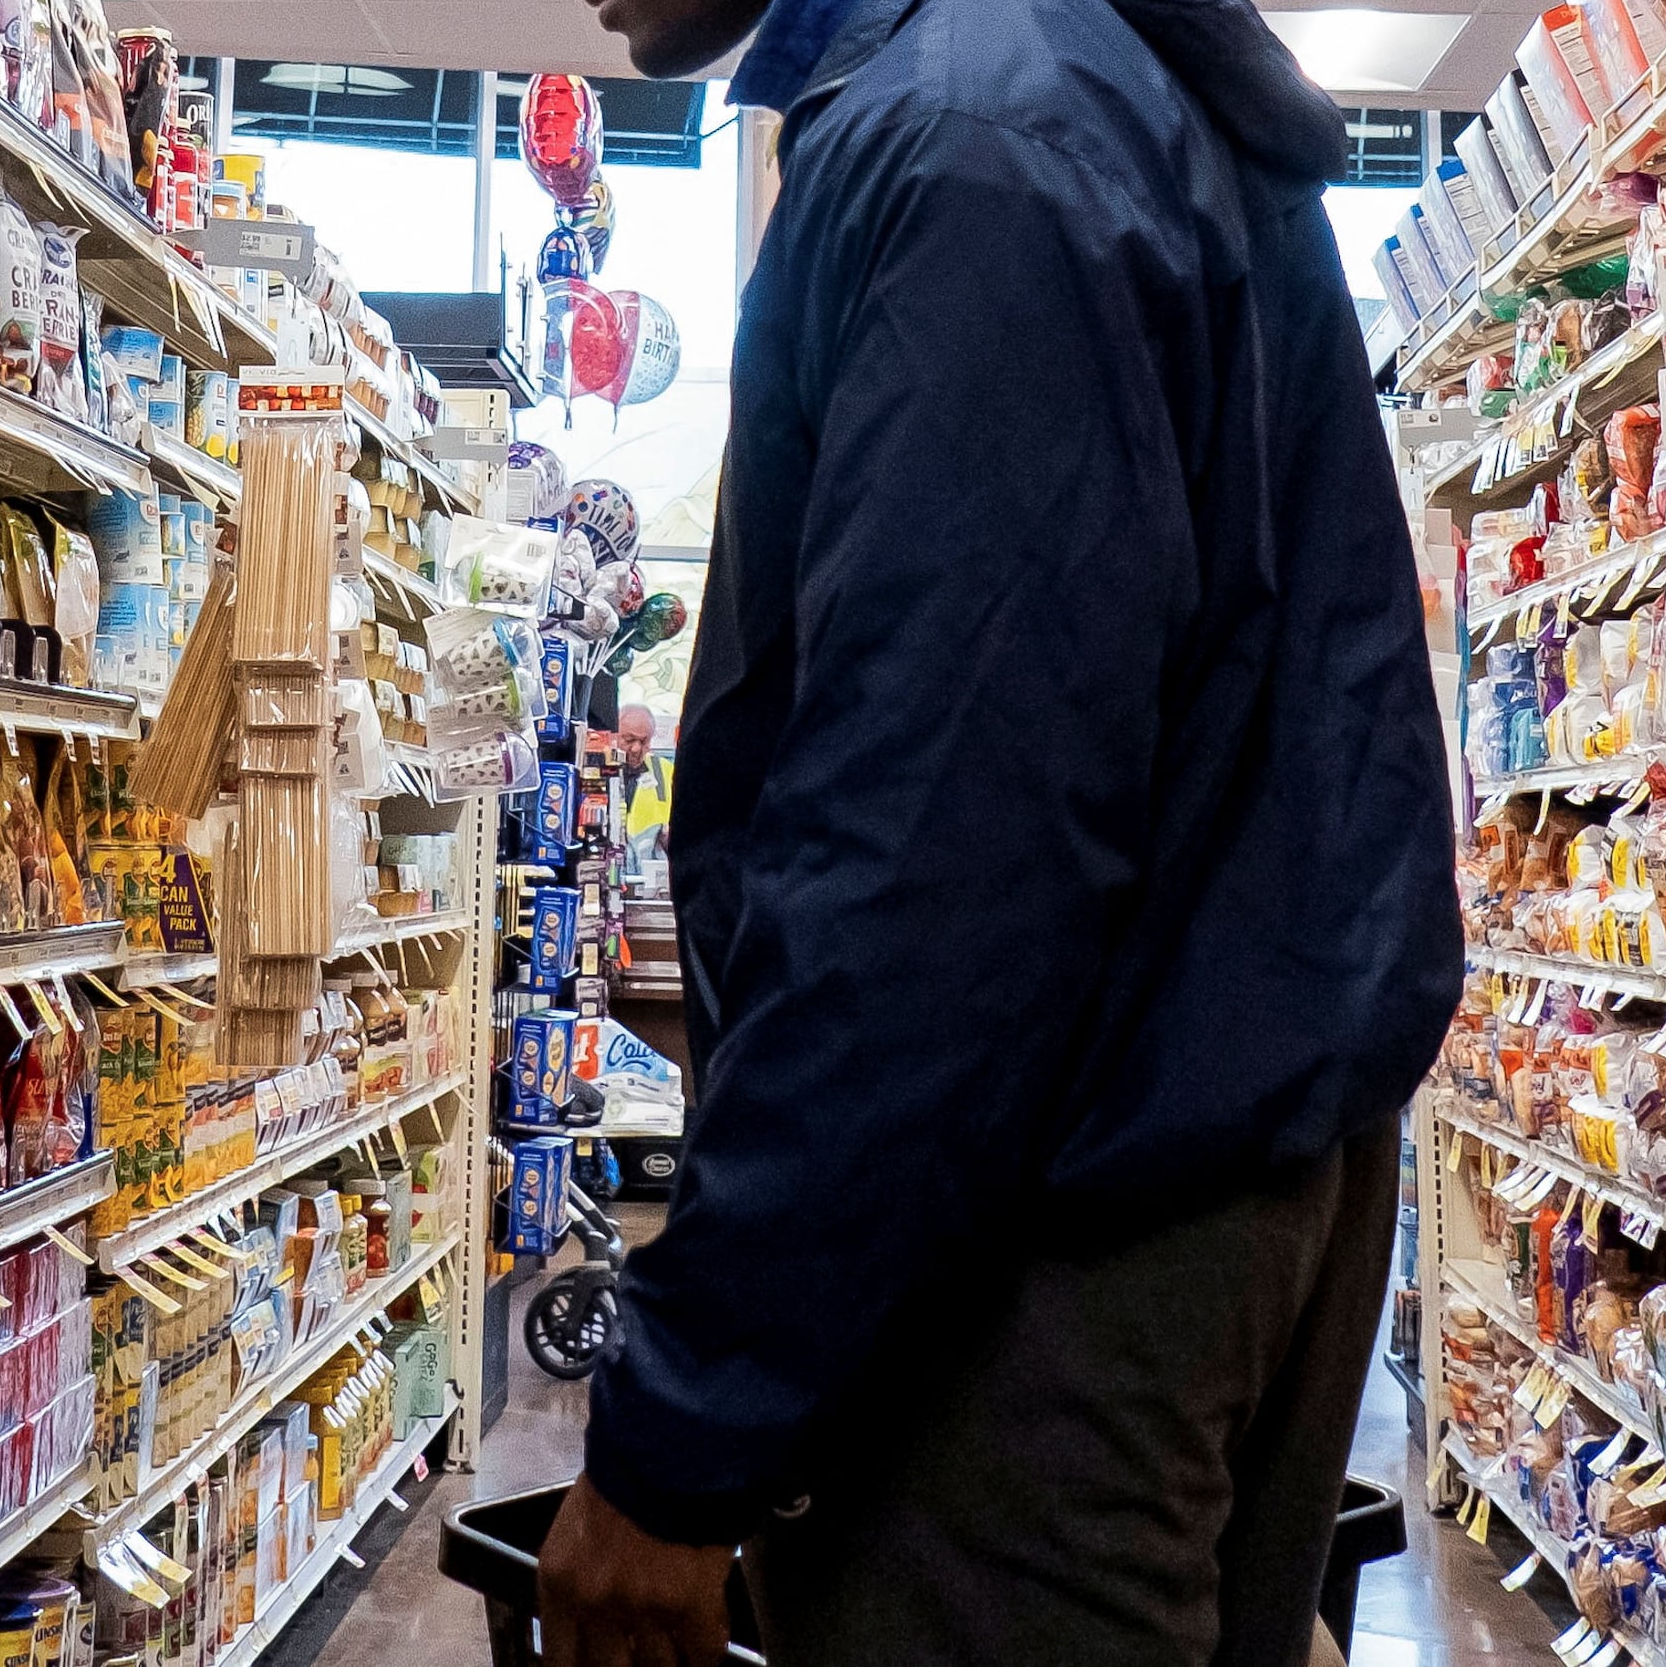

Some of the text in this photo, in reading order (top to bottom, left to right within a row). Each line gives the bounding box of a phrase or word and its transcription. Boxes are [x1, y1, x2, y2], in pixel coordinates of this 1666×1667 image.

[158, 855, 177, 885] 4
[159, 885, 188, 905] CAN
[163, 904, 194, 918] VALUE
[169, 916, 197, 932] PACK
